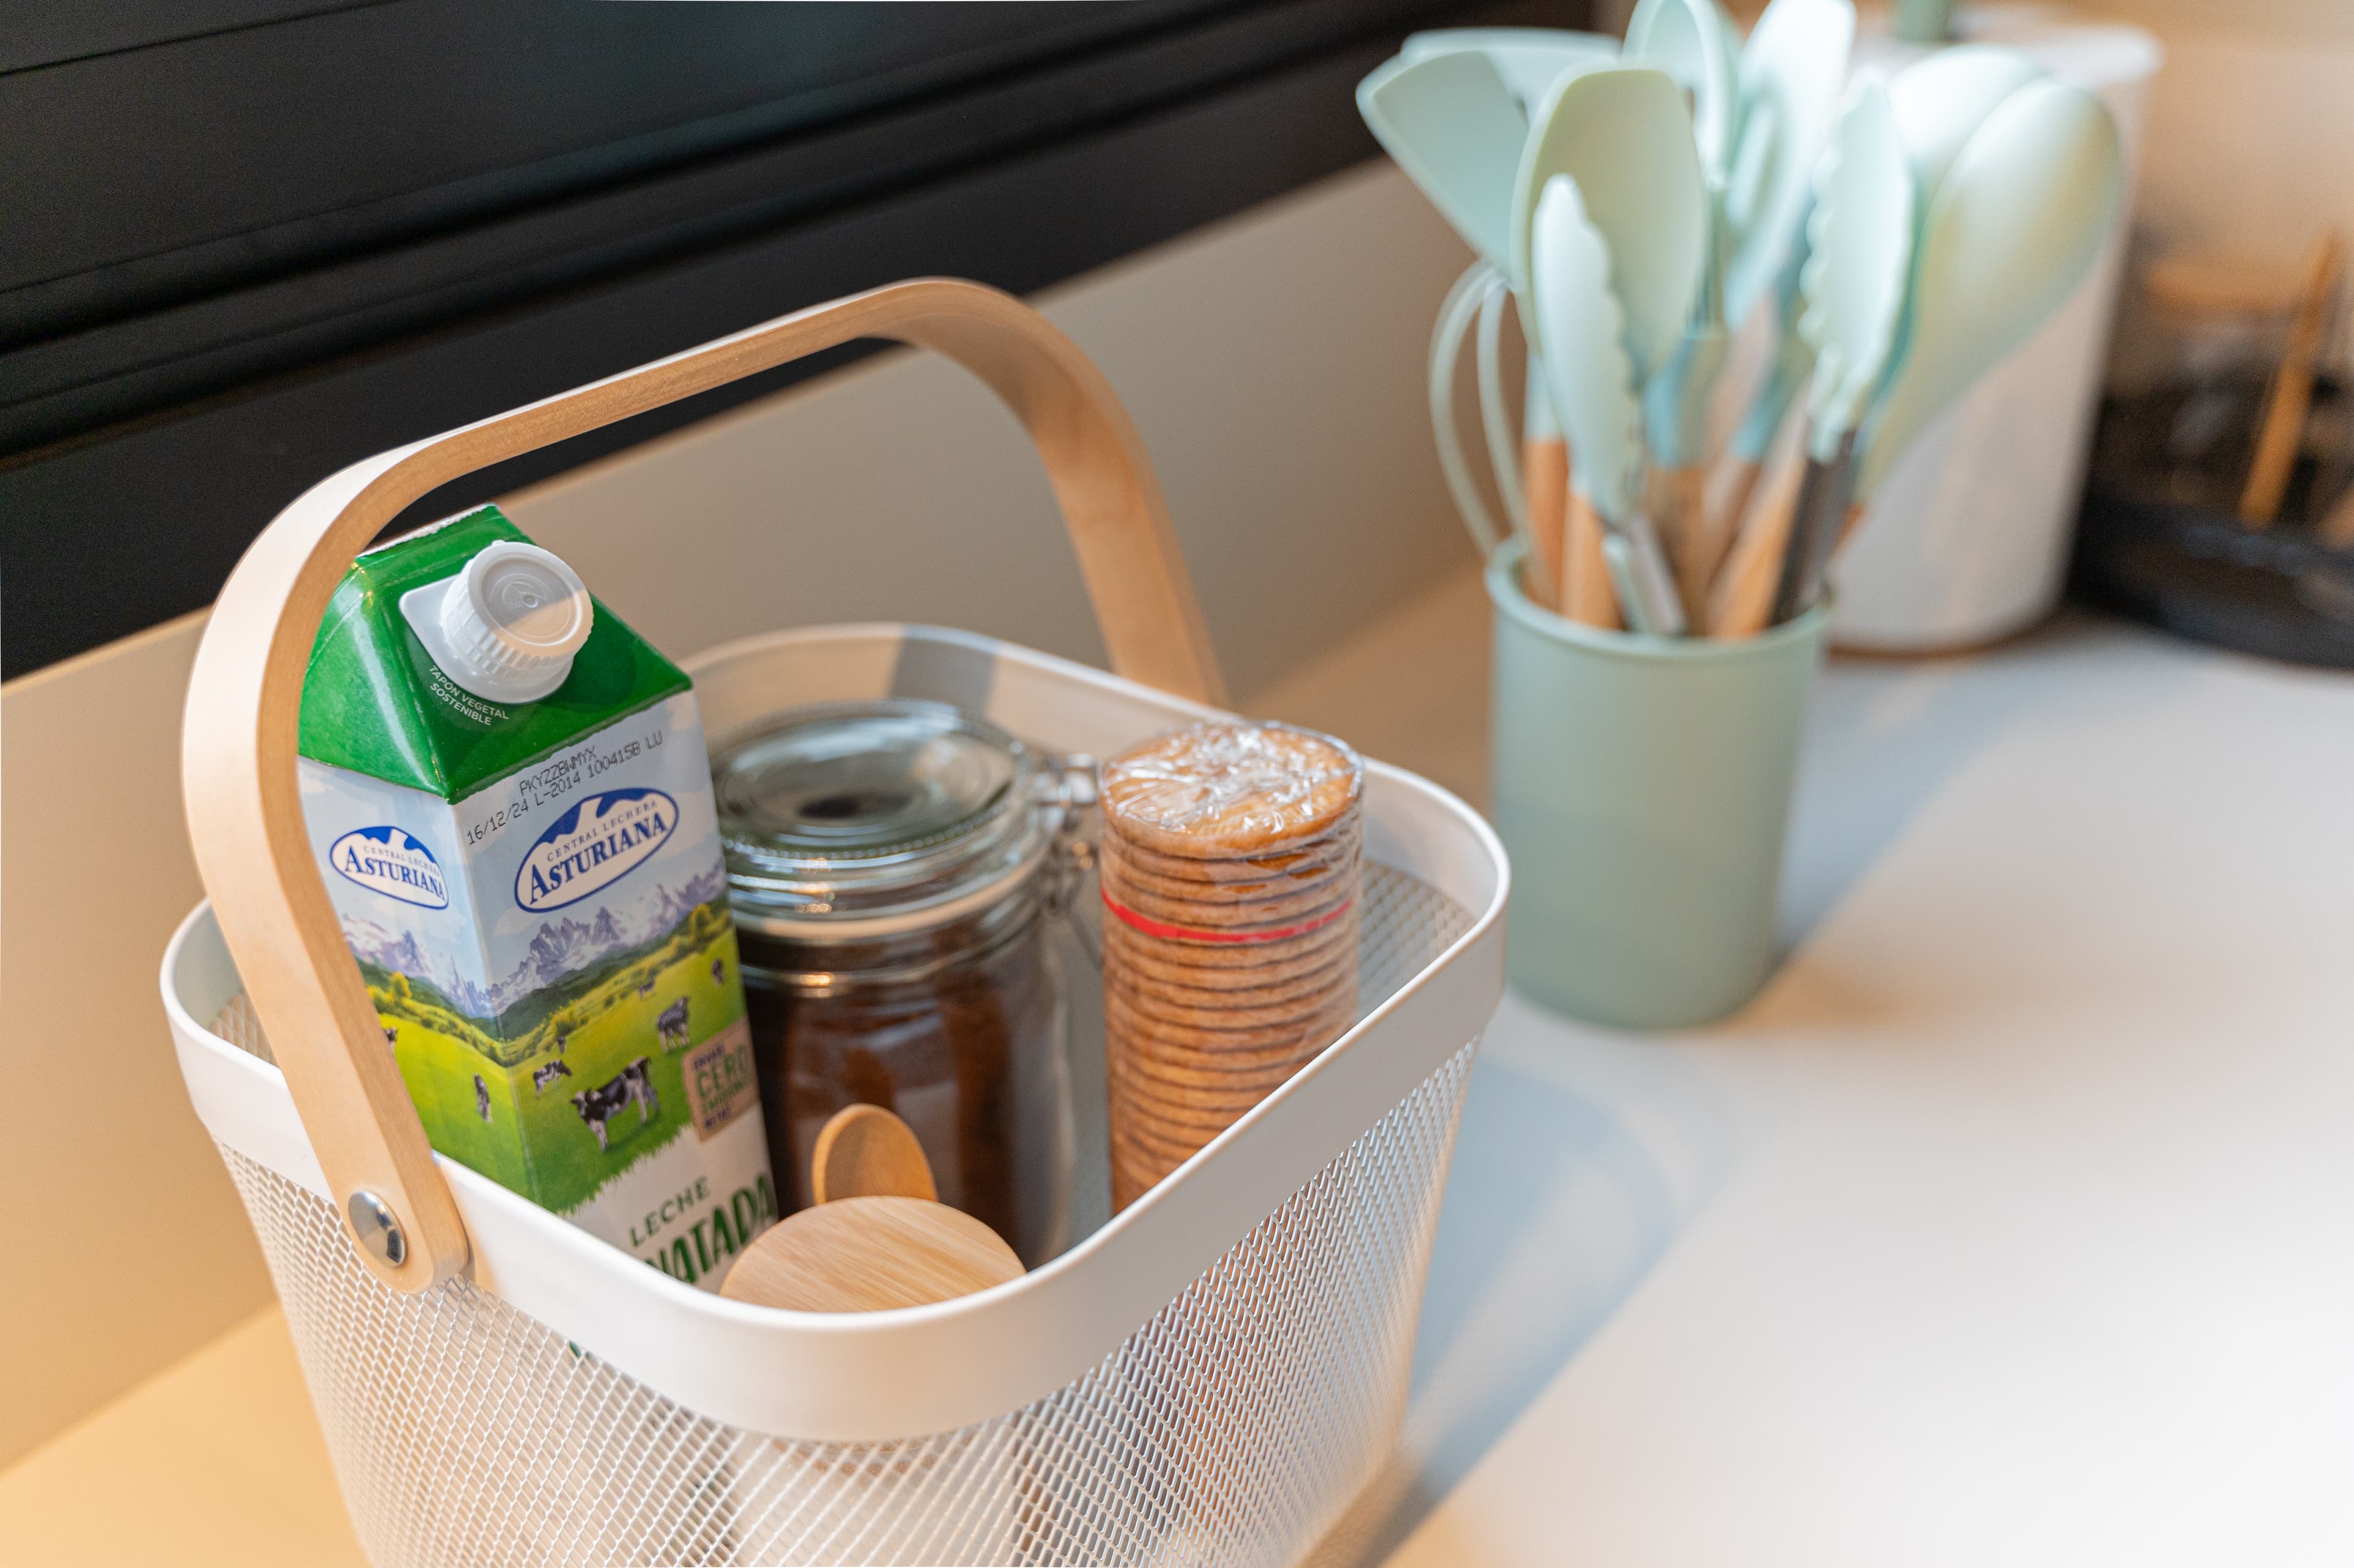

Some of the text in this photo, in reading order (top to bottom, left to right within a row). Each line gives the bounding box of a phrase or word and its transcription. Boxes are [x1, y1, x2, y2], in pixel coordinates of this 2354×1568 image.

[430, 683, 492, 726] SOSTENIBLE
[462, 694, 509, 720] VEGETAL
[467, 798, 529, 845] 16/12/24
[535, 770, 581, 806] L-2014
[646, 730, 663, 750] LU
[364, 845, 406, 861] CENTRAL
[530, 812, 670, 905] ASTURIANA
[547, 799, 658, 862] CENTRAL LECHERA
[345, 845, 446, 901] ASTURIANA
[629, 1176, 712, 1248] LECHE
